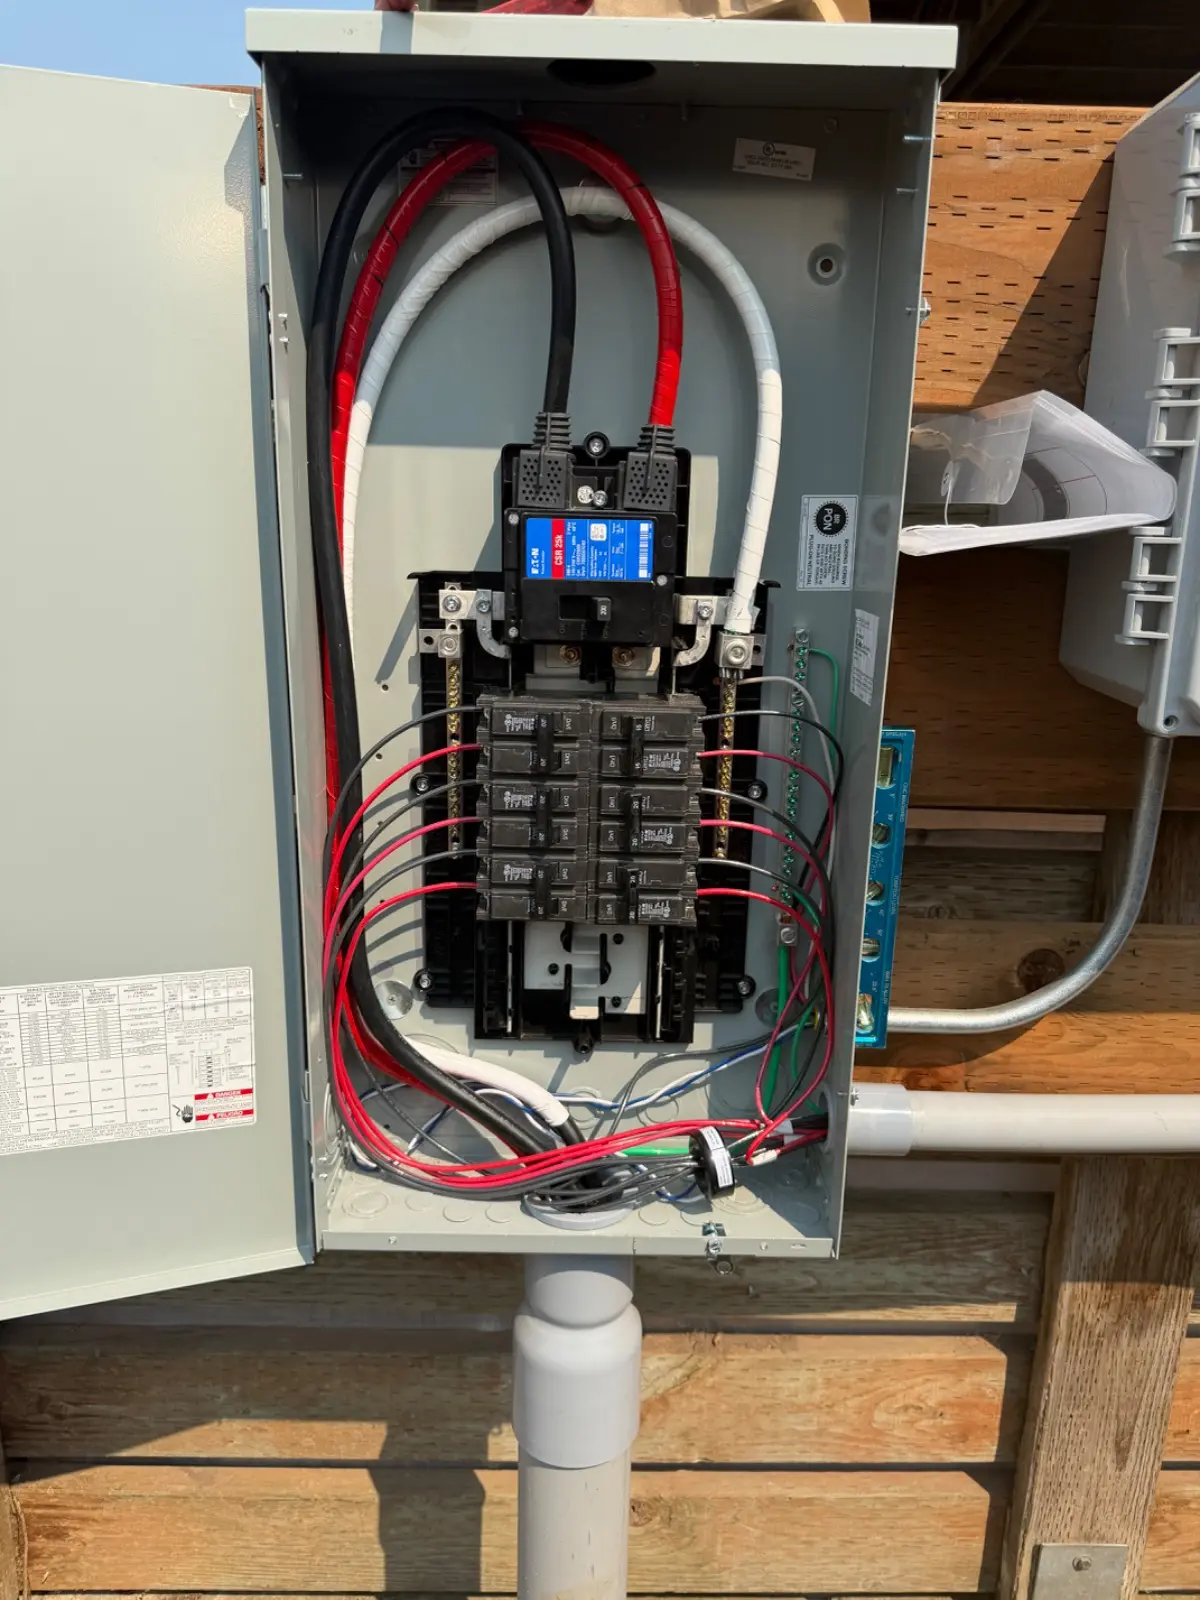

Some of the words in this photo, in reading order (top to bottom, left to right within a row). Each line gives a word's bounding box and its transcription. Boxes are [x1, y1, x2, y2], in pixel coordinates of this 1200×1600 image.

[823, 508, 833, 530] PON
[555, 535, 563, 548] 25k
[555, 550, 563, 565] CSR
[632, 838, 638, 846] 20
[630, 875, 636, 883] 20
[629, 911, 635, 919] 20
